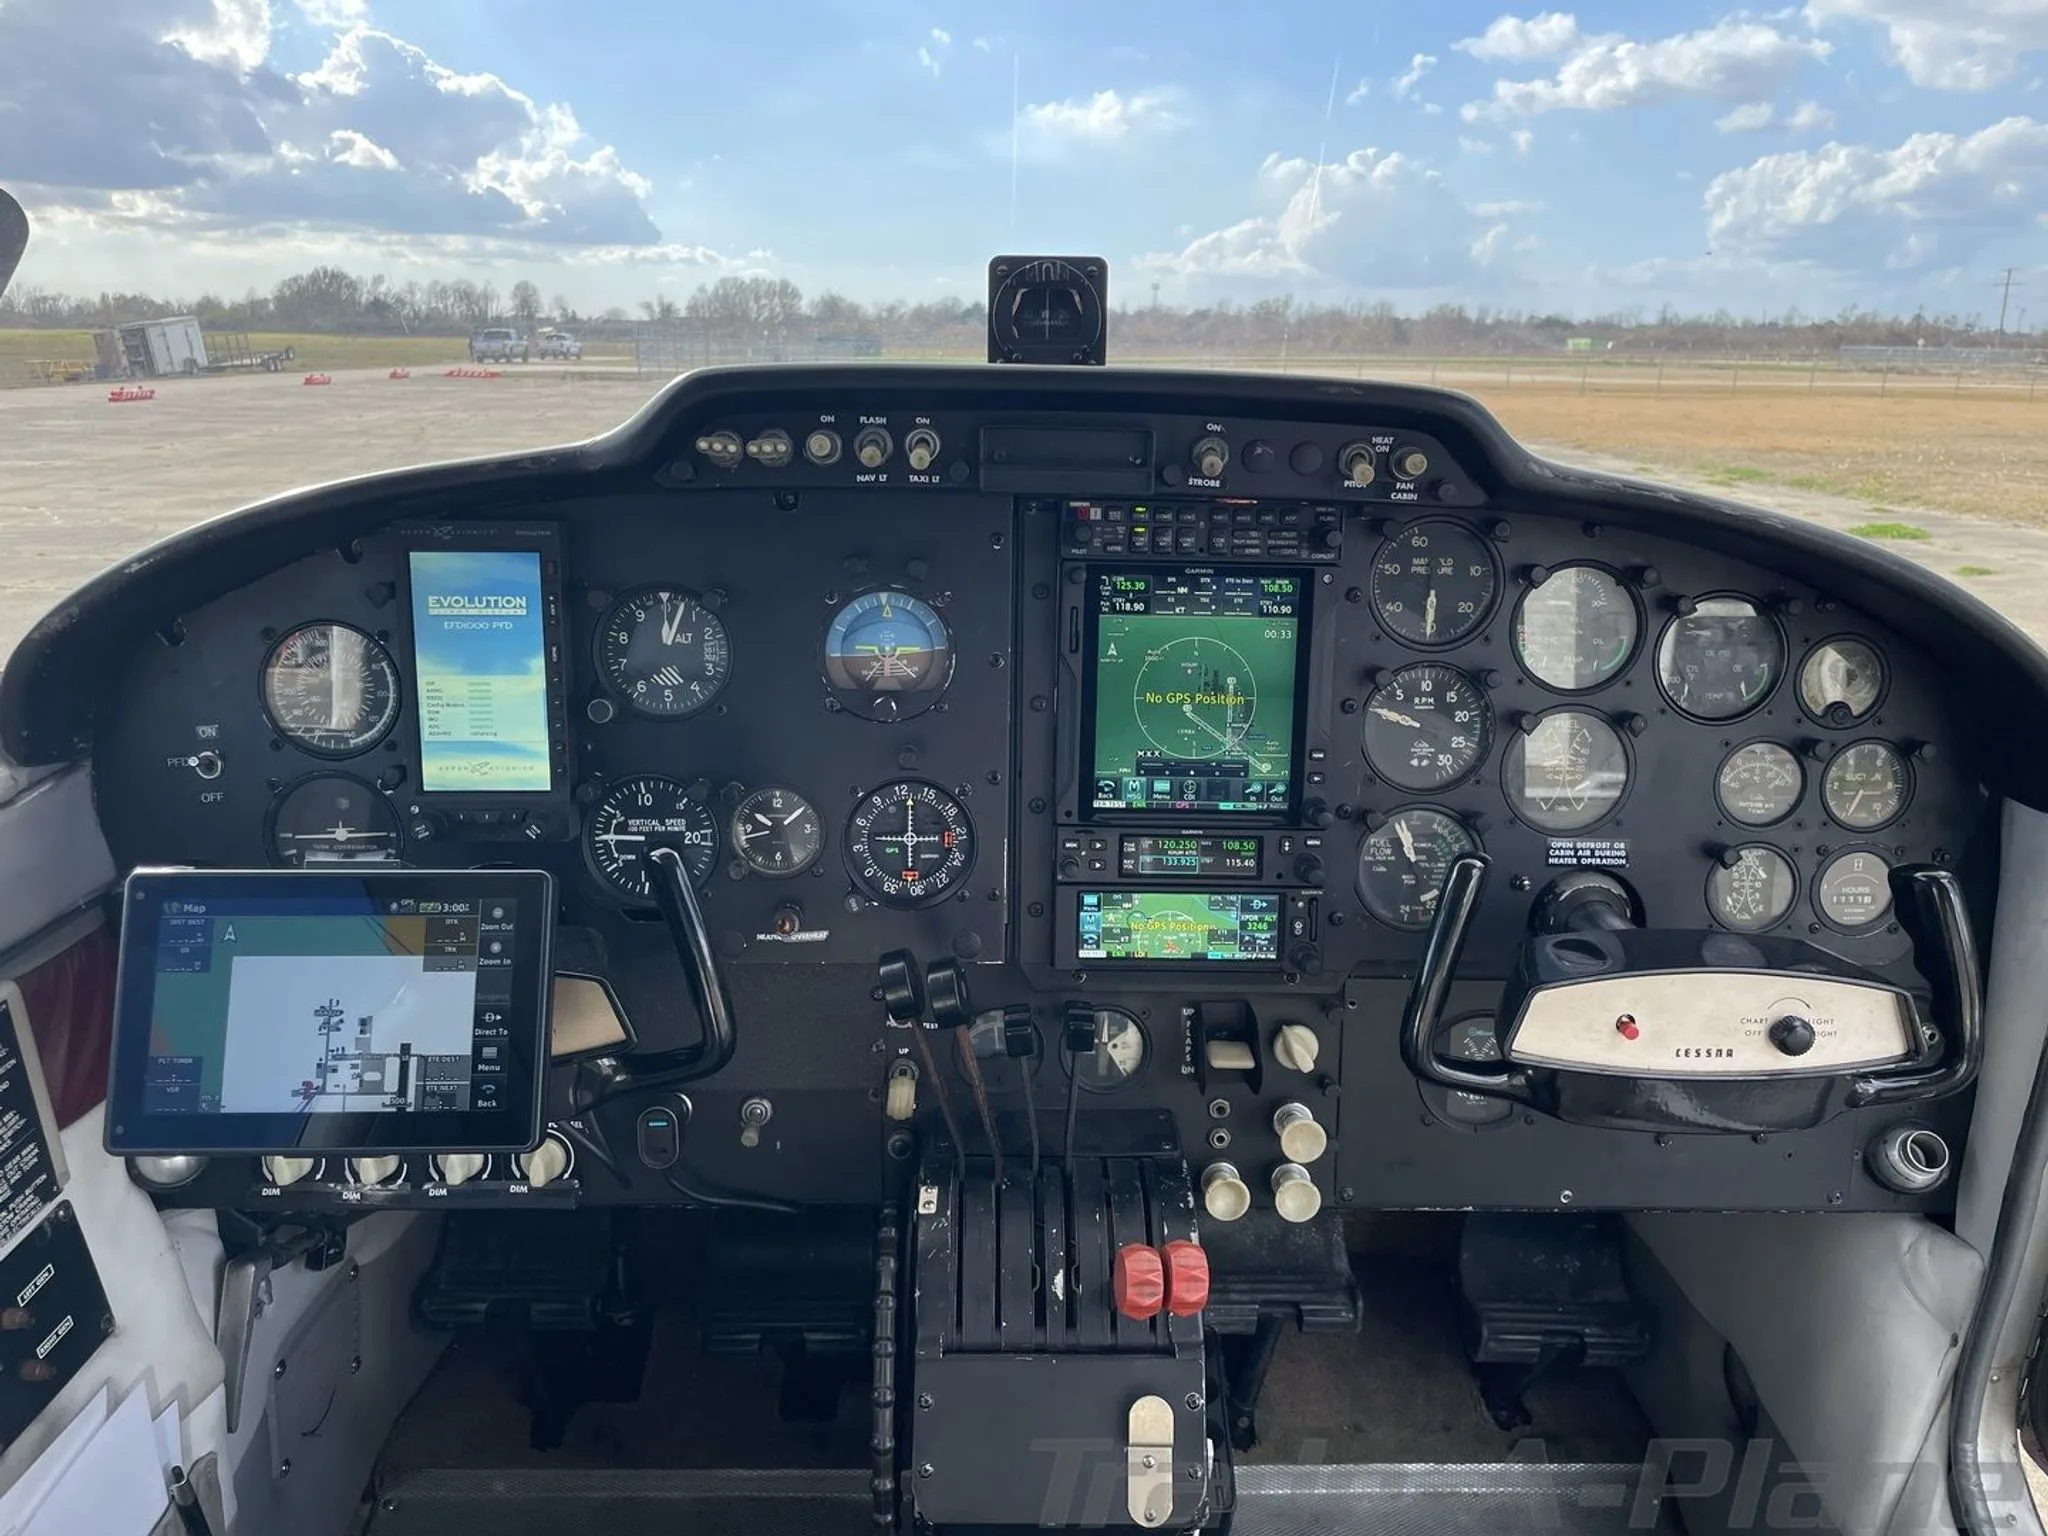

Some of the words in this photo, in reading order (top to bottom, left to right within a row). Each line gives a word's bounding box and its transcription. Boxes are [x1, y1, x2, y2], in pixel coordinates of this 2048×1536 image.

[820, 415, 834, 423] ON
[860, 416, 887, 425] FLASH
[916, 416, 930, 425] ON
[1206, 423, 1222, 432] ON
[1372, 436, 1394, 445] HEAT
[1375, 444, 1390, 453] ON
[856, 474, 876, 483] NAV
[879, 474, 888, 482] LT
[908, 475, 930, 484] TAXI
[931, 476, 940, 484] LT
[1188, 478, 1220, 488] STROBE
[1396, 482, 1414, 491] FAN
[1391, 492, 1418, 500] CABIN
[1412, 536, 1428, 548] 60
[1384, 564, 1400, 575] 50
[1470, 566, 1482, 576] 10
[1116, 582, 1145, 590] 125.30
[1264, 584, 1292, 593] 108.50
[428, 596, 526, 608] EVOLUTION
[1116, 602, 1145, 612] 118.90
[1386, 601, 1402, 612] 40
[1458, 602, 1474, 612] 20
[1263, 605, 1292, 614] 110.90
[636, 610, 645, 622] 9
[692, 610, 696, 622] 1
[444, 622, 489, 630] EFD1000
[492, 622, 513, 630] PFD
[619, 632, 628, 644] 8
[674, 632, 693, 644] ALT
[704, 628, 713, 640] 2
[1264, 630, 1292, 639] 00:33
[619, 658, 627, 671] 7
[706, 663, 714, 676] 3
[636, 680, 646, 692] 6
[690, 682, 700, 692] 4
[1421, 680, 1432, 692] 10
[664, 690, 673, 701] 5
[1146, 692, 1162, 704] No
[1166, 692, 1191, 704] GPS
[1195, 693, 1244, 705] Position
[1396, 690, 1404, 700] 5
[1446, 692, 1458, 702] 15
[1454, 711, 1470, 722] 20
[200, 727, 216, 738] ON
[1451, 736, 1466, 748] 25
[1436, 754, 1452, 766] 30
[1846, 773, 1882, 782] SUCTN
[894, 784, 908, 796] 12
[922, 787, 937, 800] 15
[202, 792, 224, 803] OFF
[638, 794, 652, 806] 10
[872, 796, 882, 806] 9
[772, 798, 782, 808] 12
[944, 802, 958, 816] 18
[856, 818, 866, 826] 6
[746, 824, 752, 832] 9
[804, 824, 812, 834] 3
[684, 832, 701, 844] 20
[956, 827, 968, 840] 21
[852, 844, 864, 852] 3
[1158, 840, 1198, 849] 120.250
[1222, 841, 1256, 850] 108.50
[1370, 839, 1392, 848] FUEL
[774, 852, 782, 860] 6
[951, 851, 965, 866] 24
[1162, 858, 1196, 866] 133.925
[1226, 858, 1256, 868] 115.40
[864, 868, 875, 878] 0
[936, 874, 950, 888] 27
[883, 881, 898, 894] 33
[910, 886, 926, 896] 30
[183, 904, 206, 914] Map
[442, 904, 465, 912] 3:00
[1131, 922, 1145, 930] No
[1148, 922, 1166, 930] GPS
[1170, 923, 1208, 931] Position
[1184, 1008, 1196, 1016] UP
[1676, 1048, 1734, 1058] CESSNA
[1182, 1064, 1195, 1075] DN
[478, 1100, 497, 1108] Back
[262, 1188, 280, 1196] DIM
[429, 1188, 448, 1196] DIM
[510, 1184, 528, 1193] DIM
[342, 1191, 361, 1200] DIM
[36, 1270, 49, 1286] GEN
